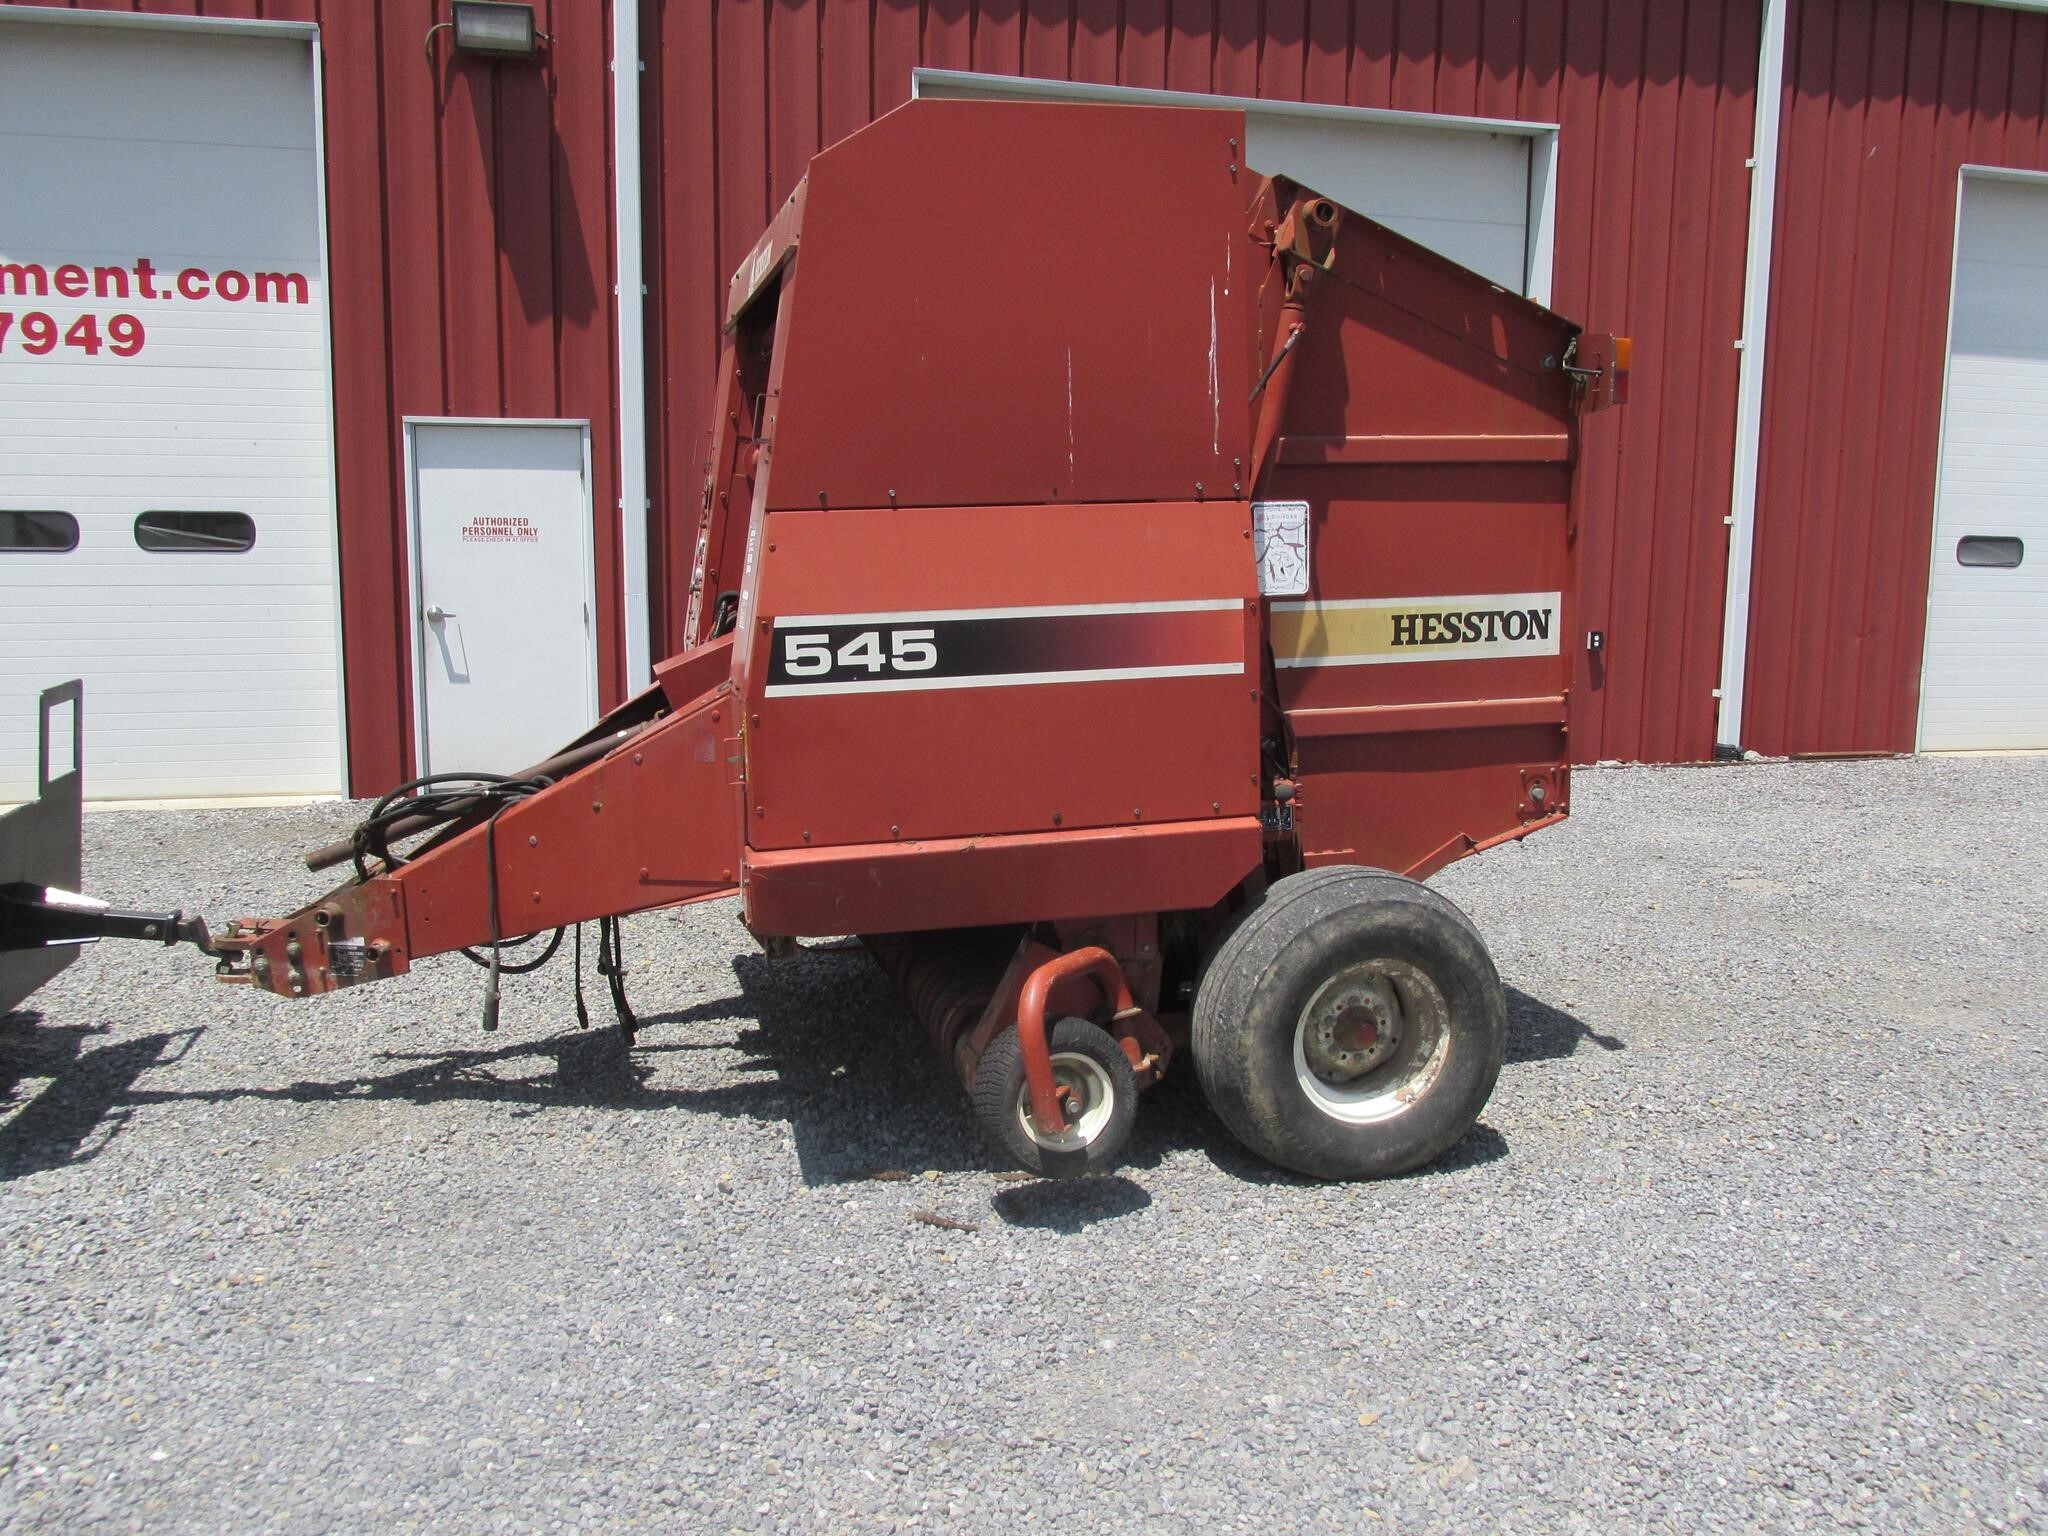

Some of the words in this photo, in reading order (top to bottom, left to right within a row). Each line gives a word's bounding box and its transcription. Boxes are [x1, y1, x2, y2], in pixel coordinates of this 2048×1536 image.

[0, 258, 309, 304] ment.com
[462, 526, 514, 536] PERSONNEL
[517, 527, 539, 536] ONLY
[472, 516, 529, 527] AUTHORIZED
[1391, 608, 1552, 646] HESSTON
[784, 629, 938, 676] 545
